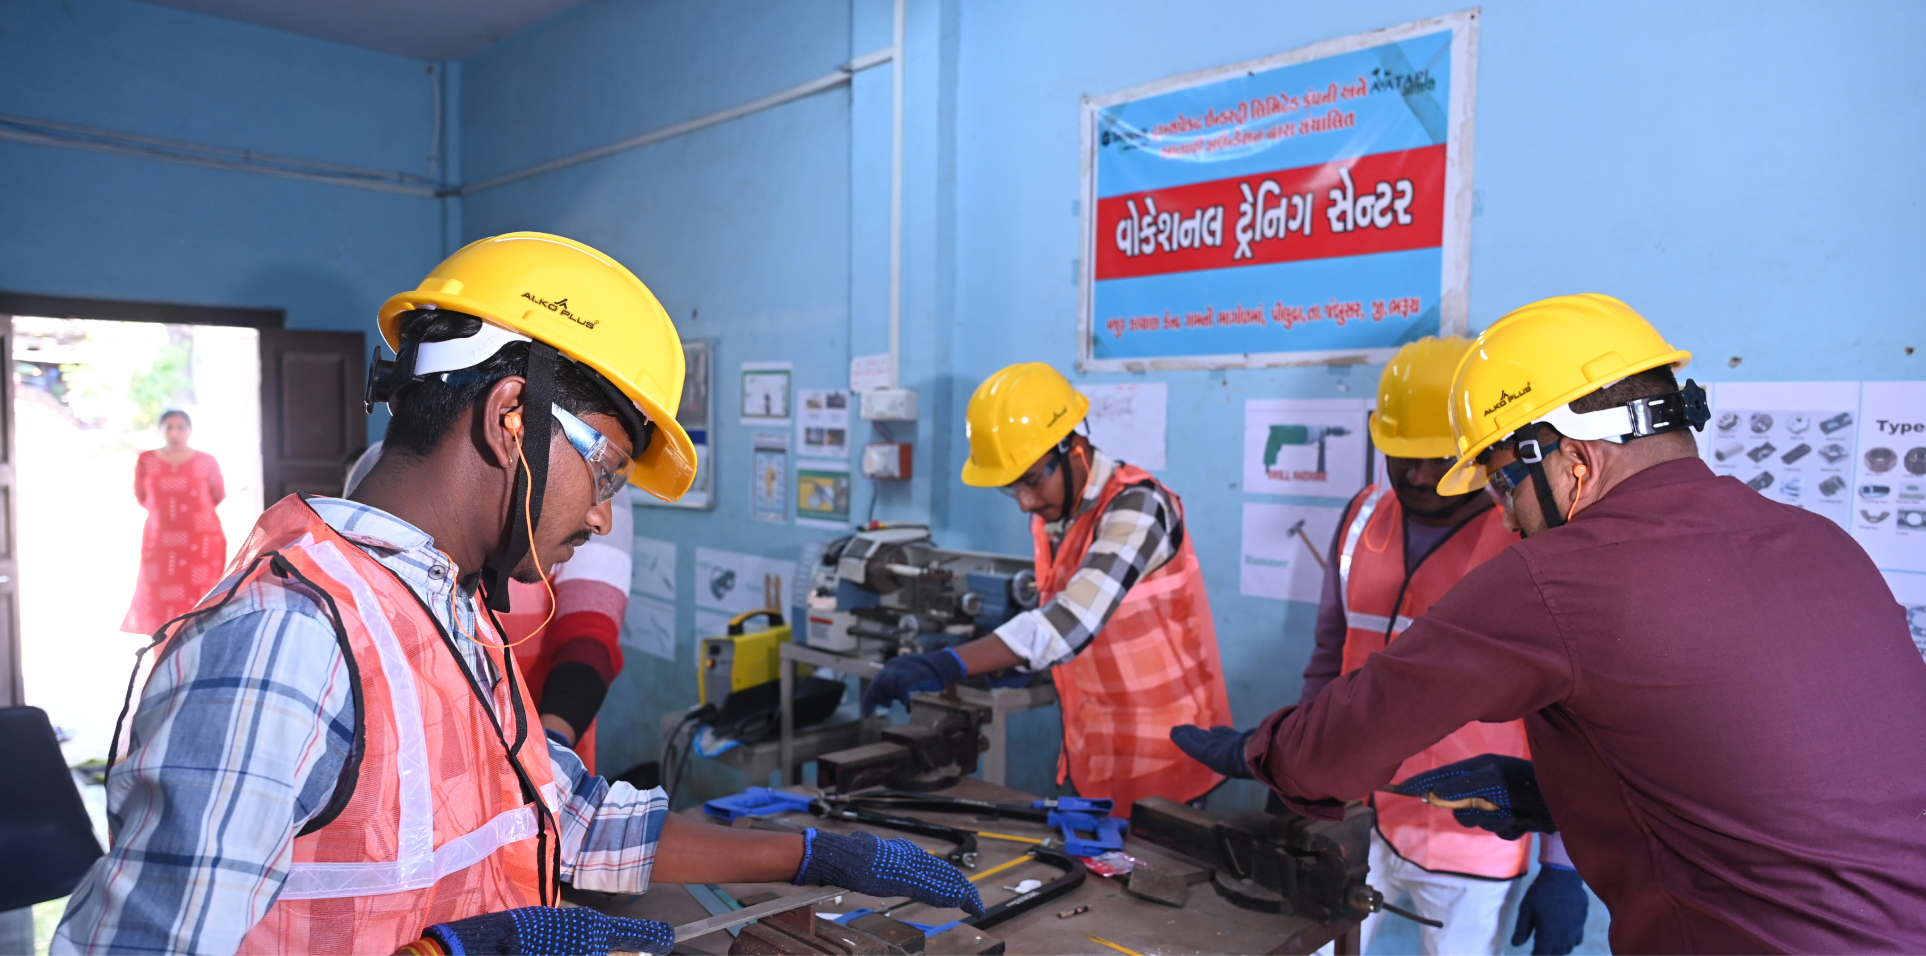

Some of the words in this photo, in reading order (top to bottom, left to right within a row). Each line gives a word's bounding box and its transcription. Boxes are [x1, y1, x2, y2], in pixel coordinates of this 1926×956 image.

[1302, 81, 1338, 108] કંપની
[1340, 75, 1368, 99] અને
[1298, 108, 1356, 135] સંચાલિત
[1115, 195, 1225, 258] વોકેશનલ
[1326, 166, 1415, 234] સેન્ટર
[520, 291, 558, 312] ALKO
[1483, 399, 1507, 417] ALKO
[1507, 385, 1532, 403] PLUS
